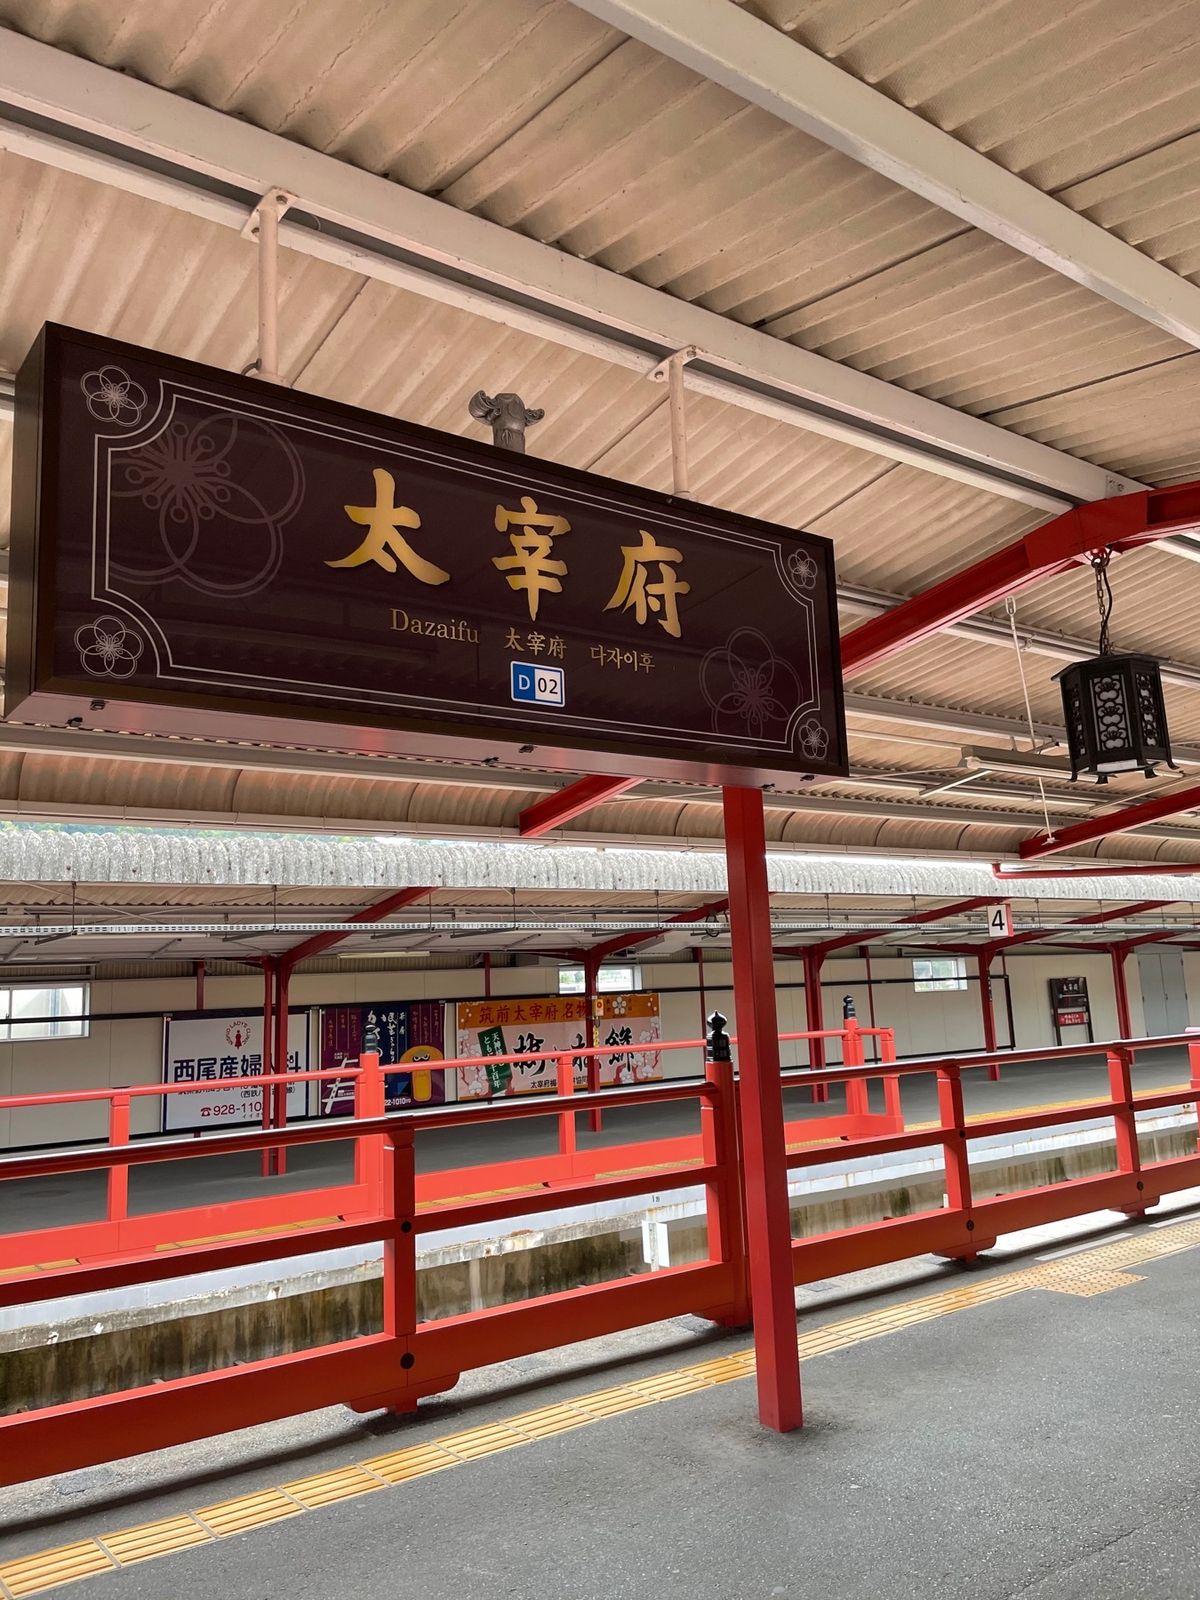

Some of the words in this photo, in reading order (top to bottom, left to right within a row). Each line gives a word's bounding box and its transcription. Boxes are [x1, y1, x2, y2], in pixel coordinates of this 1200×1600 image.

[324, 468, 691, 638] 太宰府
[389, 608, 481, 644] Dazaifu
[503, 627, 568, 660] 太宰府
[590, 645, 656, 673] 다자이후
[518, 673, 531, 691] D
[537, 677, 559, 695] 02
[991, 909, 1005, 931] 4
[479, 1002, 588, 1024] 筑前太宰府名物
[173, 1051, 302, 1083] 西尾産婦科
[213, 1101, 264, 1116] 928-110
